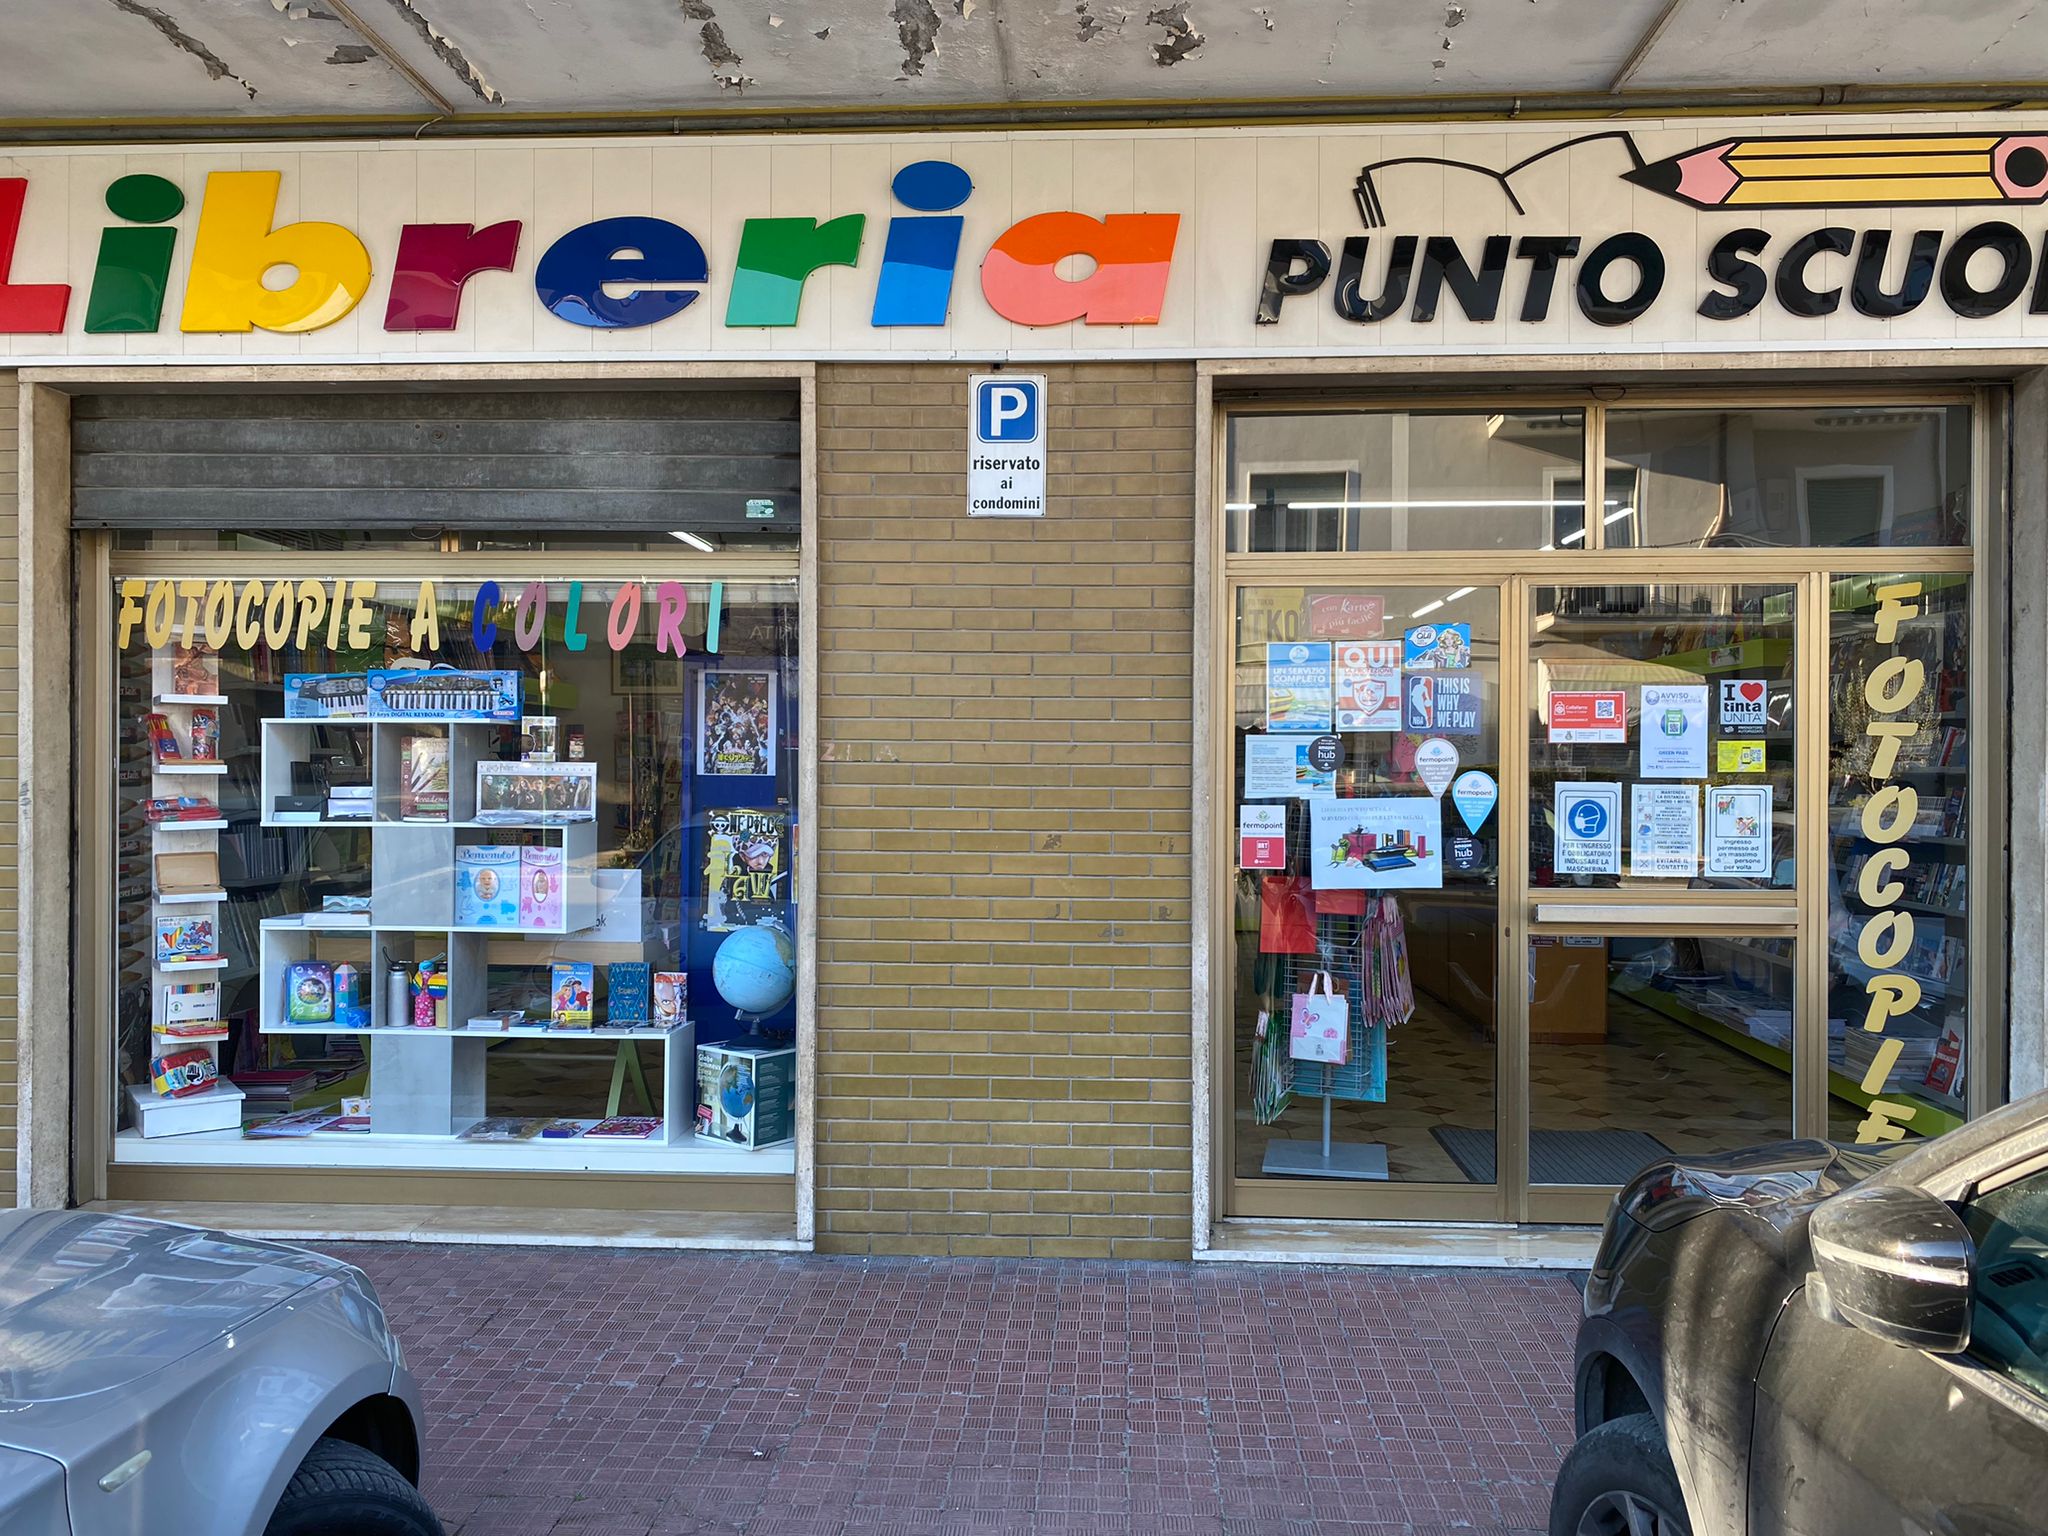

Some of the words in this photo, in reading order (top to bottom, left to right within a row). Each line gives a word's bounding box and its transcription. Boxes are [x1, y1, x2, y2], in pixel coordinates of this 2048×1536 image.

[0, 160, 1181, 333] Libreria
[1256, 231, 1666, 326] PUNTO
[1697, 220, 2048, 322] SCUO
[991, 387, 1028, 437] P
[973, 455, 1040, 470] riservato
[1001, 477, 1013, 489] ai
[973, 497, 1040, 509] condomini
[118, 579, 377, 651] FOTOCOPIE
[411, 580, 440, 652] A
[472, 580, 723, 658] COLORI
[1343, 648, 1394, 668] QUI
[1272, 674, 1326, 682] COMPLETO
[1288, 667, 1326, 675] SERVIZIO
[1437, 677, 1459, 694] THIS
[1460, 678, 1470, 694] IS
[1723, 684, 1736, 701] I
[1437, 694, 1460, 710] WHY
[1723, 702, 1762, 712] tinta
[1412, 717, 1424, 725] NBA
[1437, 711, 1452, 727] WE
[1453, 711, 1476, 727] PLAY
[1318, 750, 1336, 758] hub
[460, 848, 515, 859] Benvenuto!
[1454, 848, 1473, 857] hub
